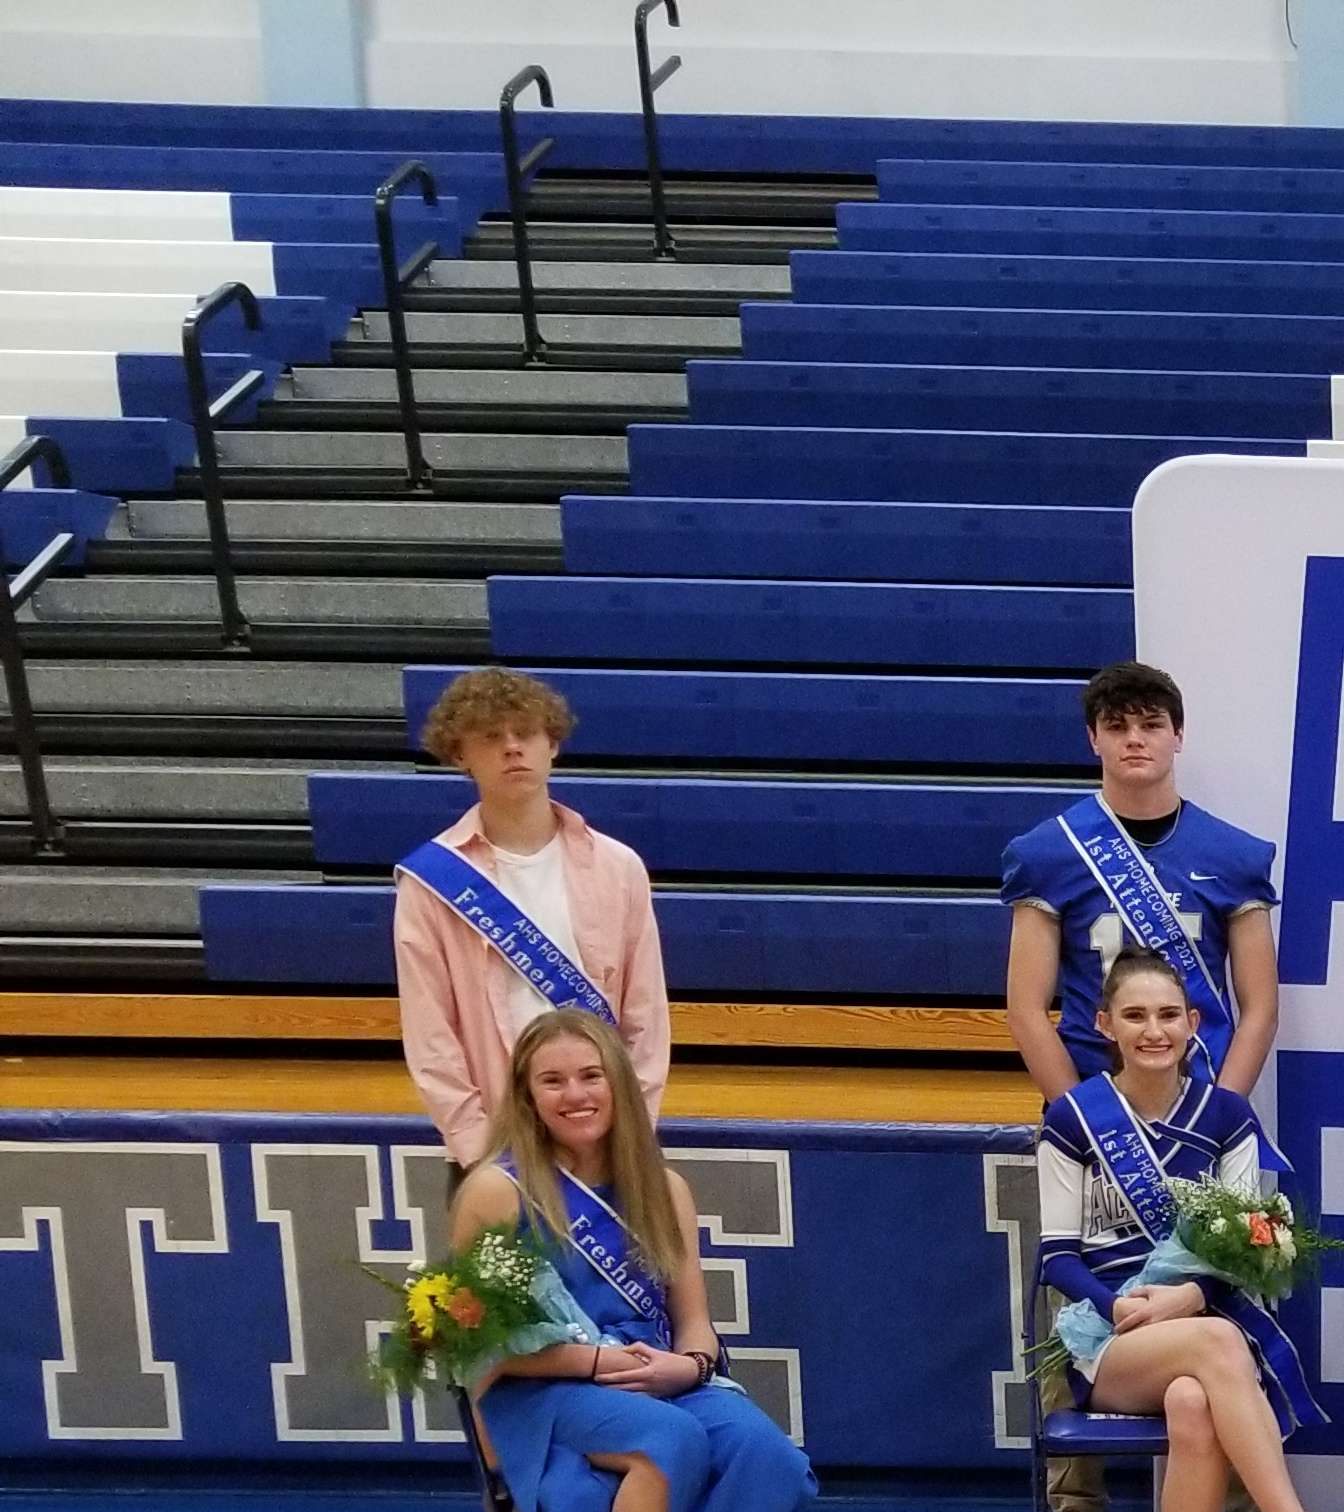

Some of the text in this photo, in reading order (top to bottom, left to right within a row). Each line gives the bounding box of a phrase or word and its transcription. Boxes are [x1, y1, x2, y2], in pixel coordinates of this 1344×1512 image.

[512, 918, 542, 946] AHS
[1083, 835, 1111, 867] 1st
[1106, 872, 1187, 981] Attend
[1108, 837, 1197, 972] AHS HOMECOMING 2021
[452, 887, 556, 996] Freshmen
[1098, 1129, 1126, 1164] 1st
[1122, 1132, 1146, 1160] AHS
